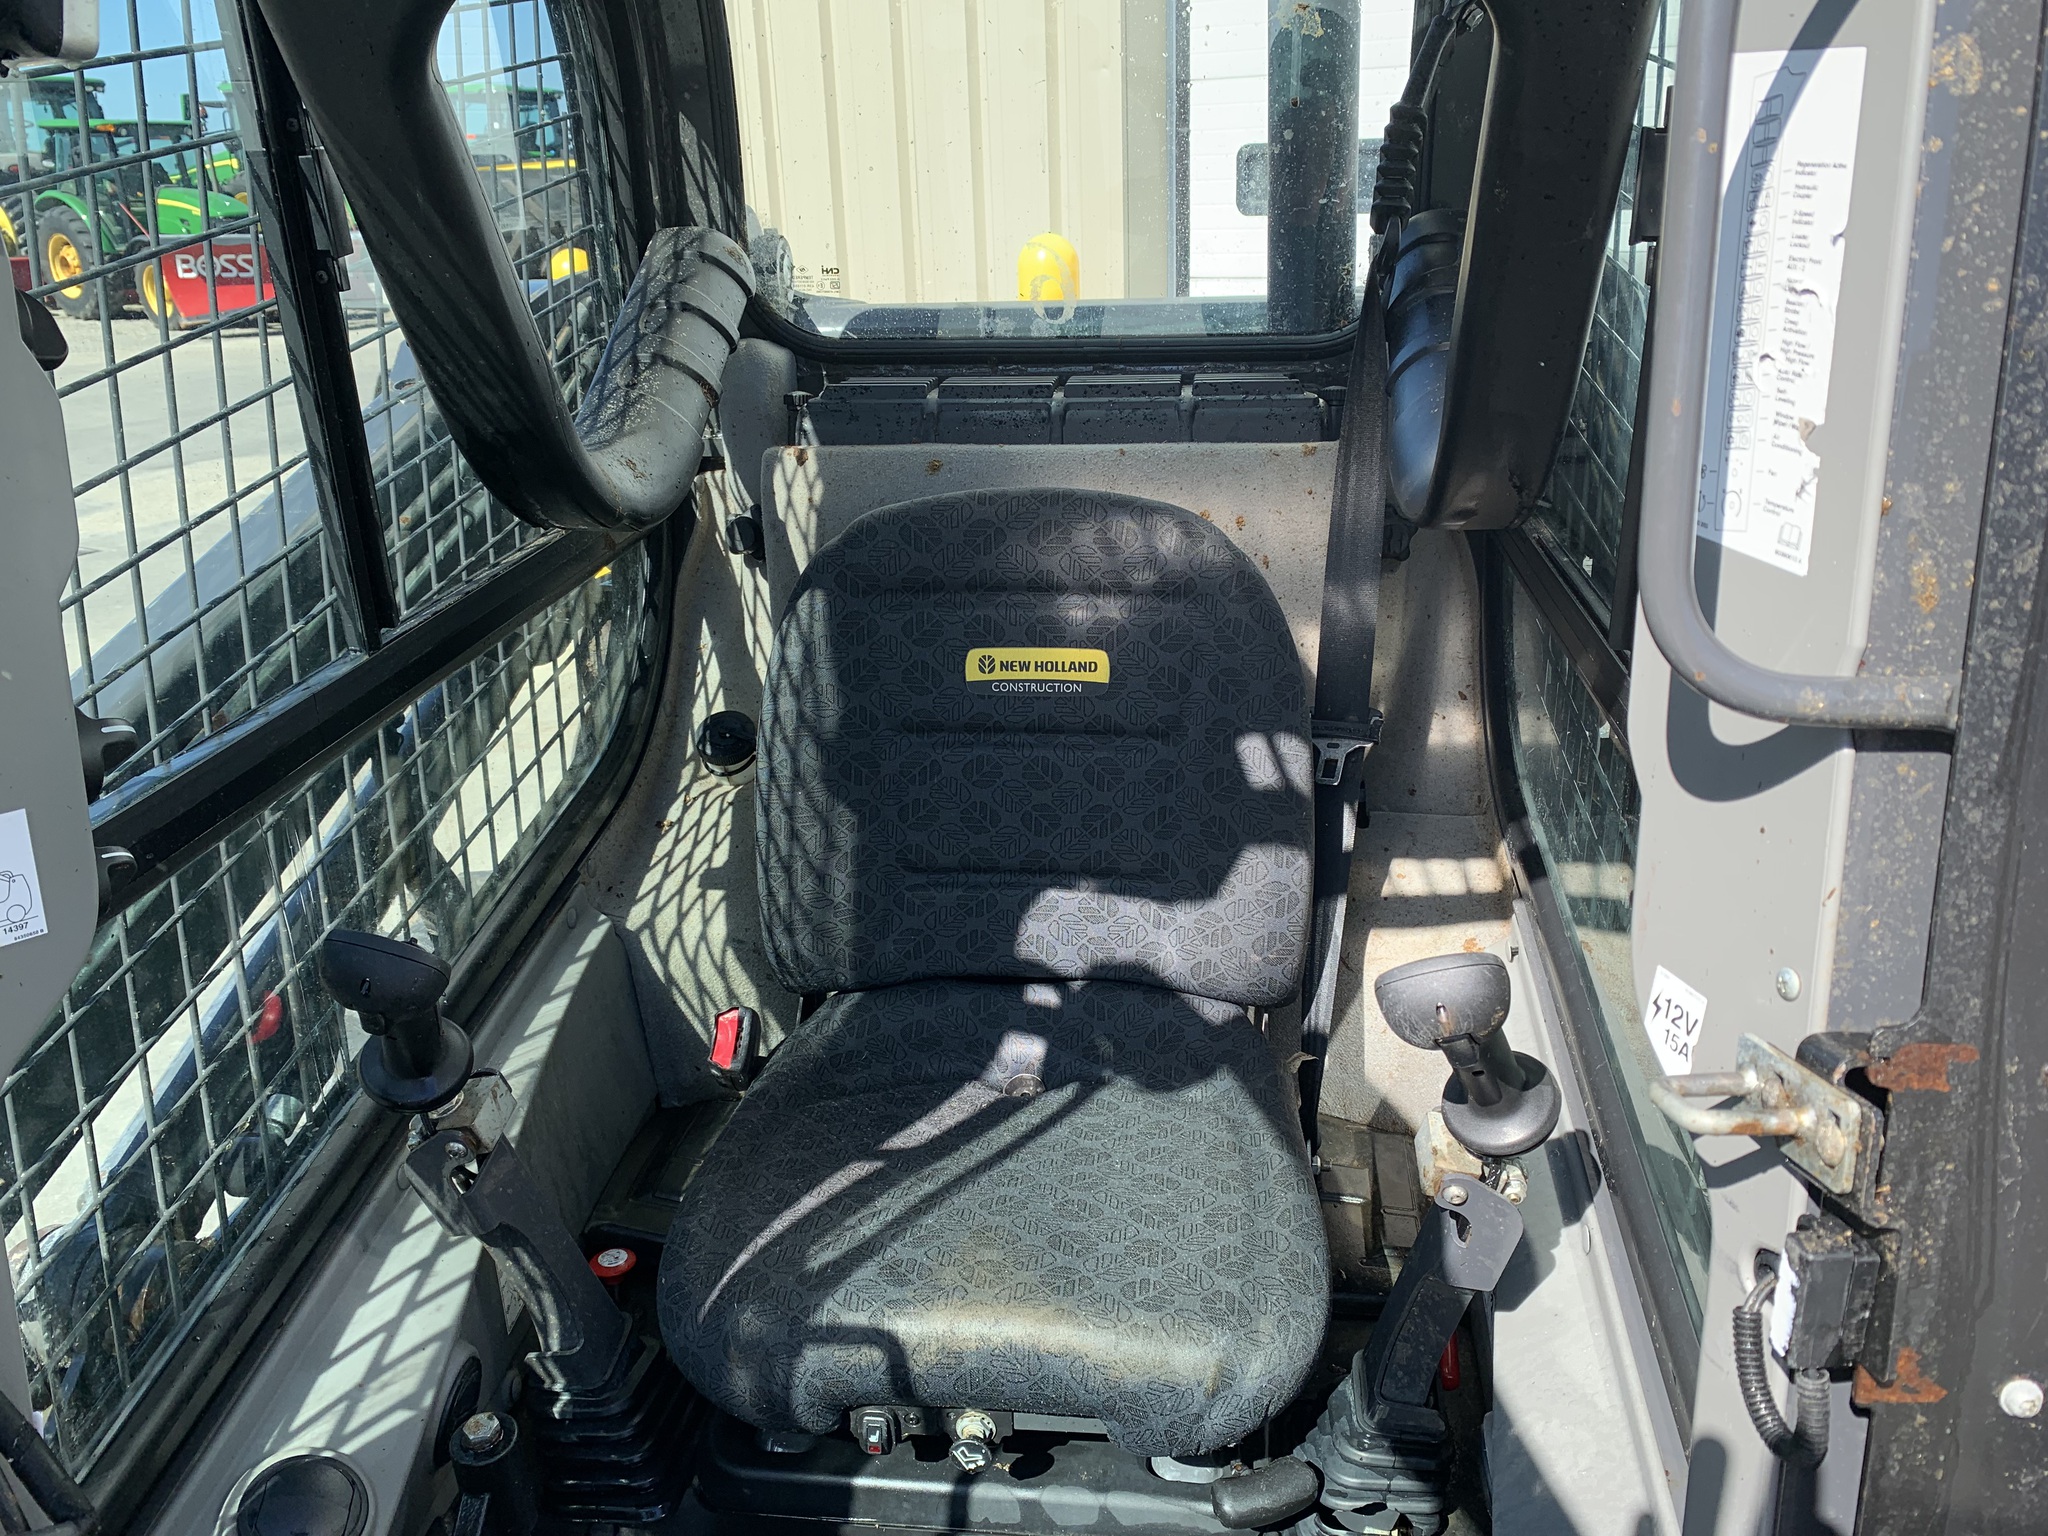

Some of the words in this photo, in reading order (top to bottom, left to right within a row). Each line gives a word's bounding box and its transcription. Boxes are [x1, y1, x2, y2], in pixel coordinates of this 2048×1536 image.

[175, 254, 254, 278] BOSS
[1000, 660, 1031, 672] NEW
[1034, 660, 1098, 673] HOLLAND
[992, 682, 1082, 693] CONSTRUCTION
[3, 922, 28, 934] 14397
[1664, 998, 1698, 1036] 12V
[1664, 1028, 1688, 1062] 15A
